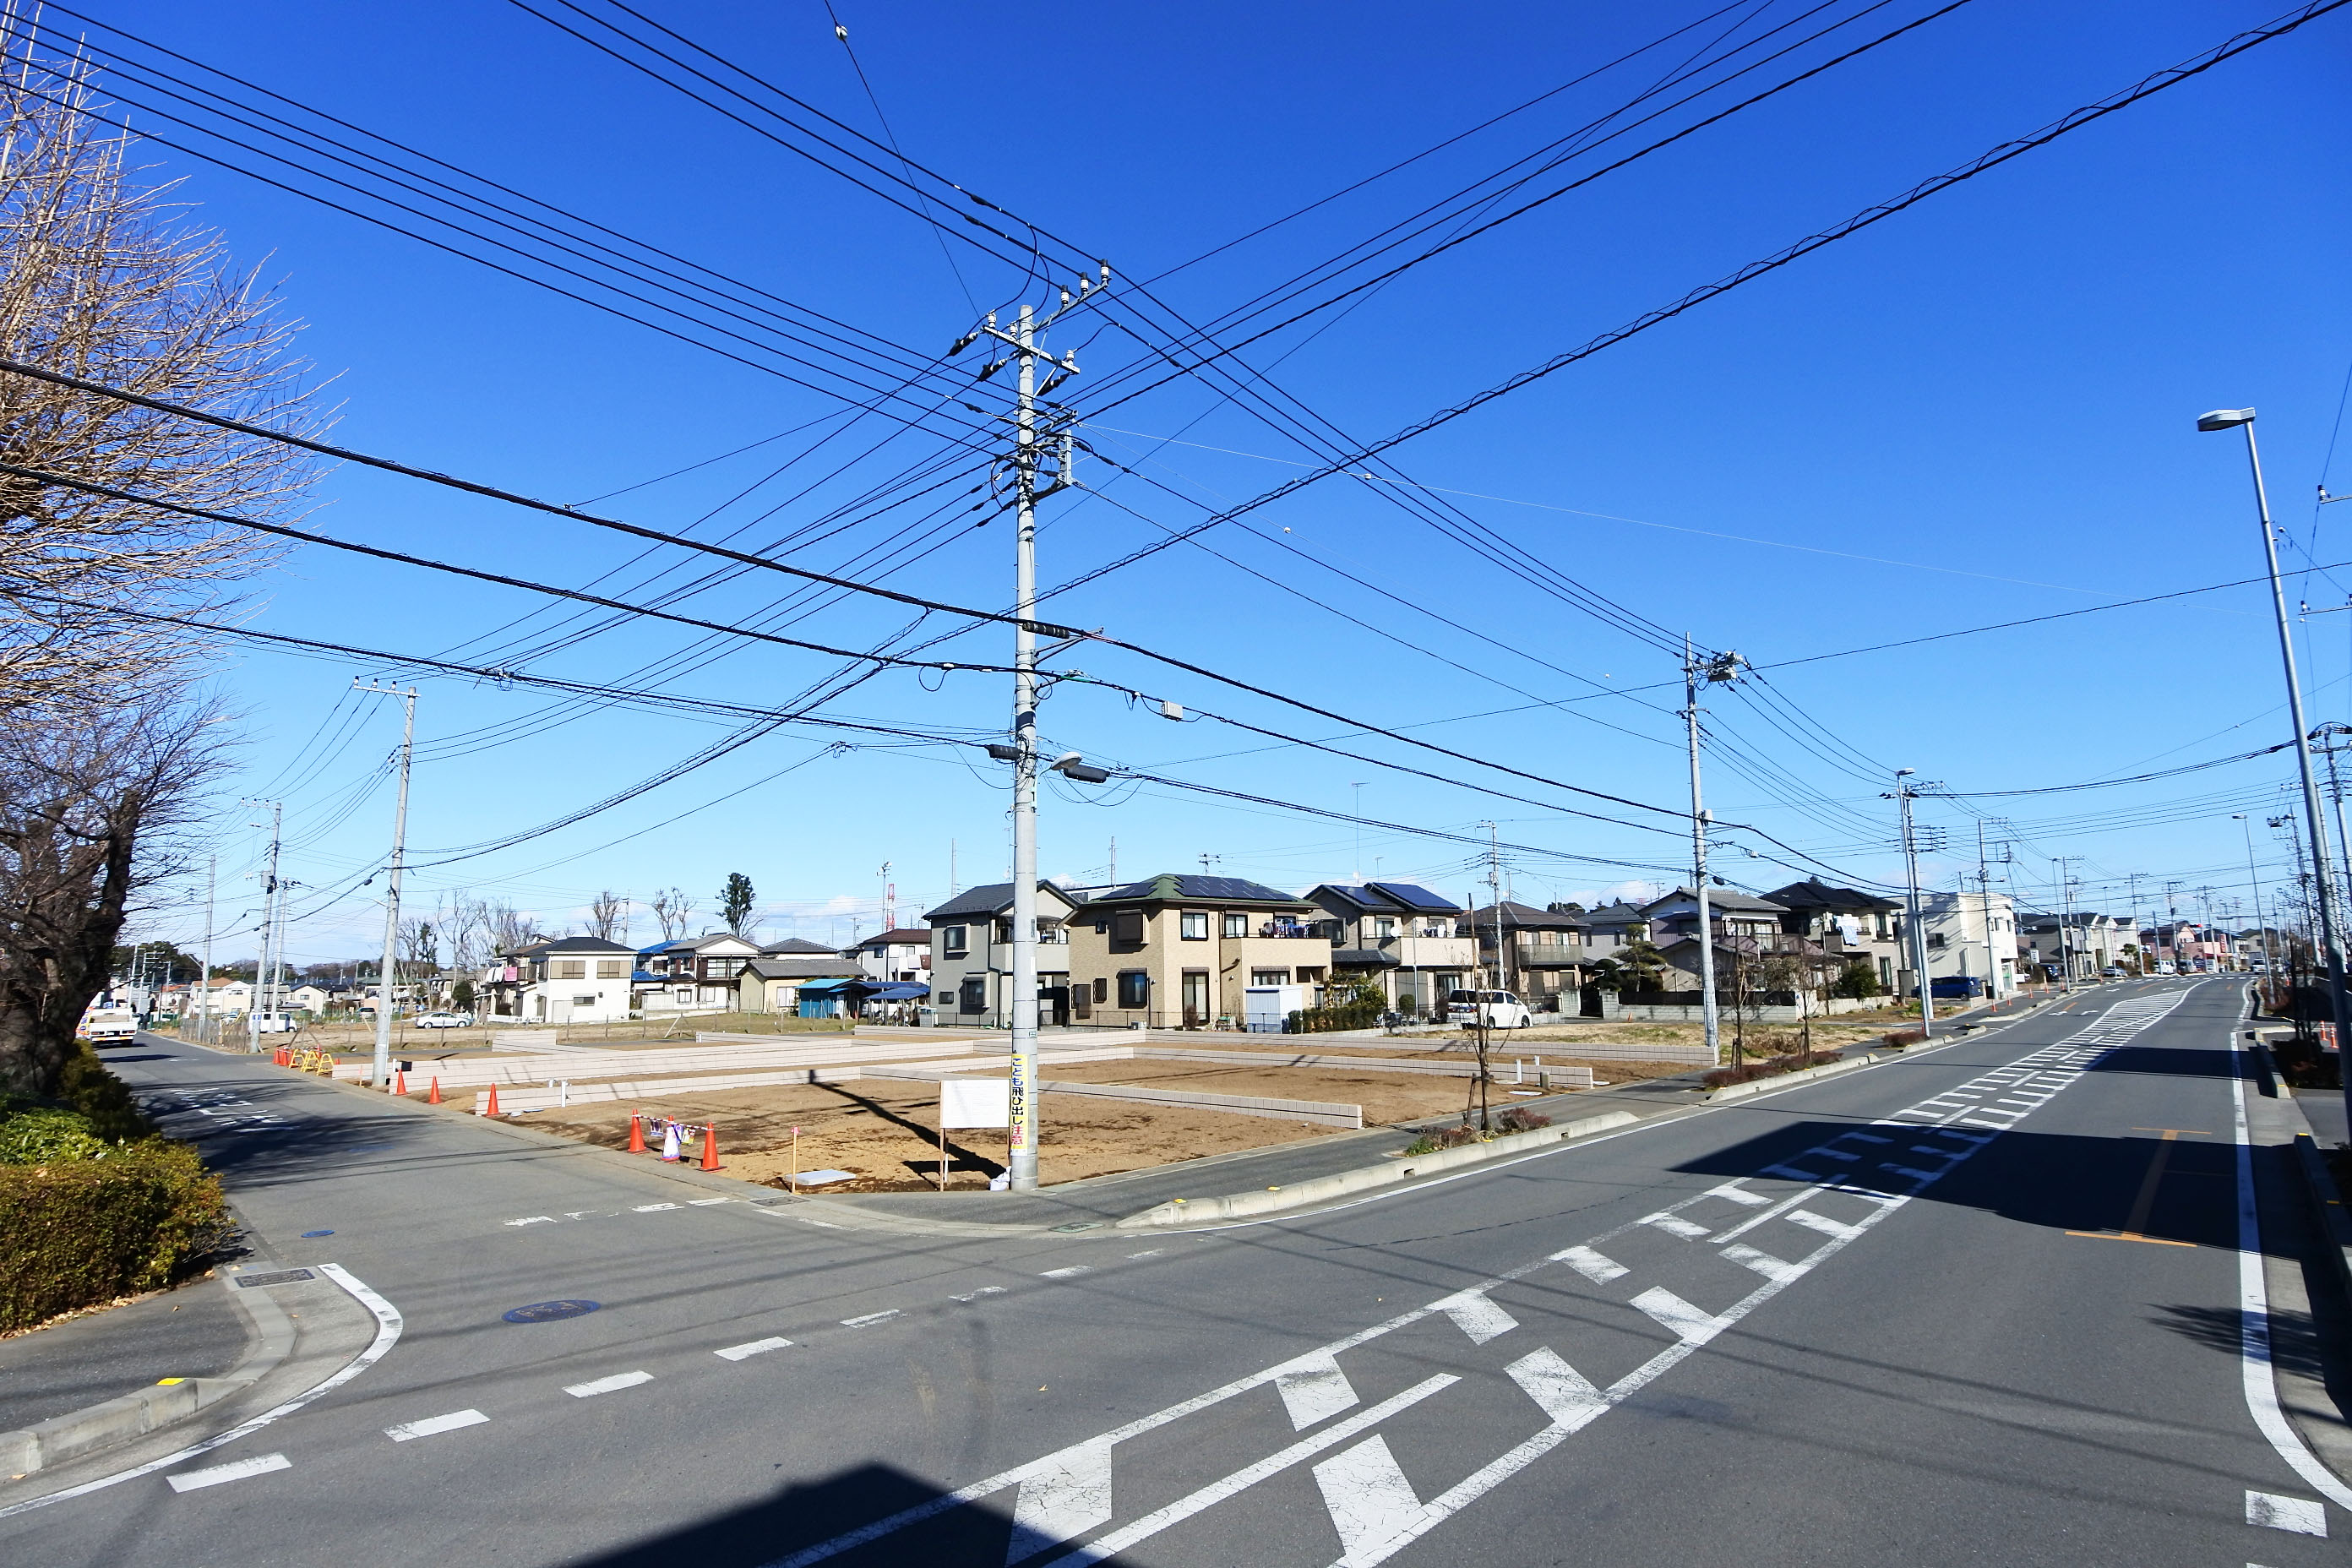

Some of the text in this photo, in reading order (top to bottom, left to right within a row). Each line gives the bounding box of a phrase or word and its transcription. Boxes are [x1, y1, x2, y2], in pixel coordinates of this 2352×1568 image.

[1011, 1058, 1024, 1145] こども飛び出し注意
